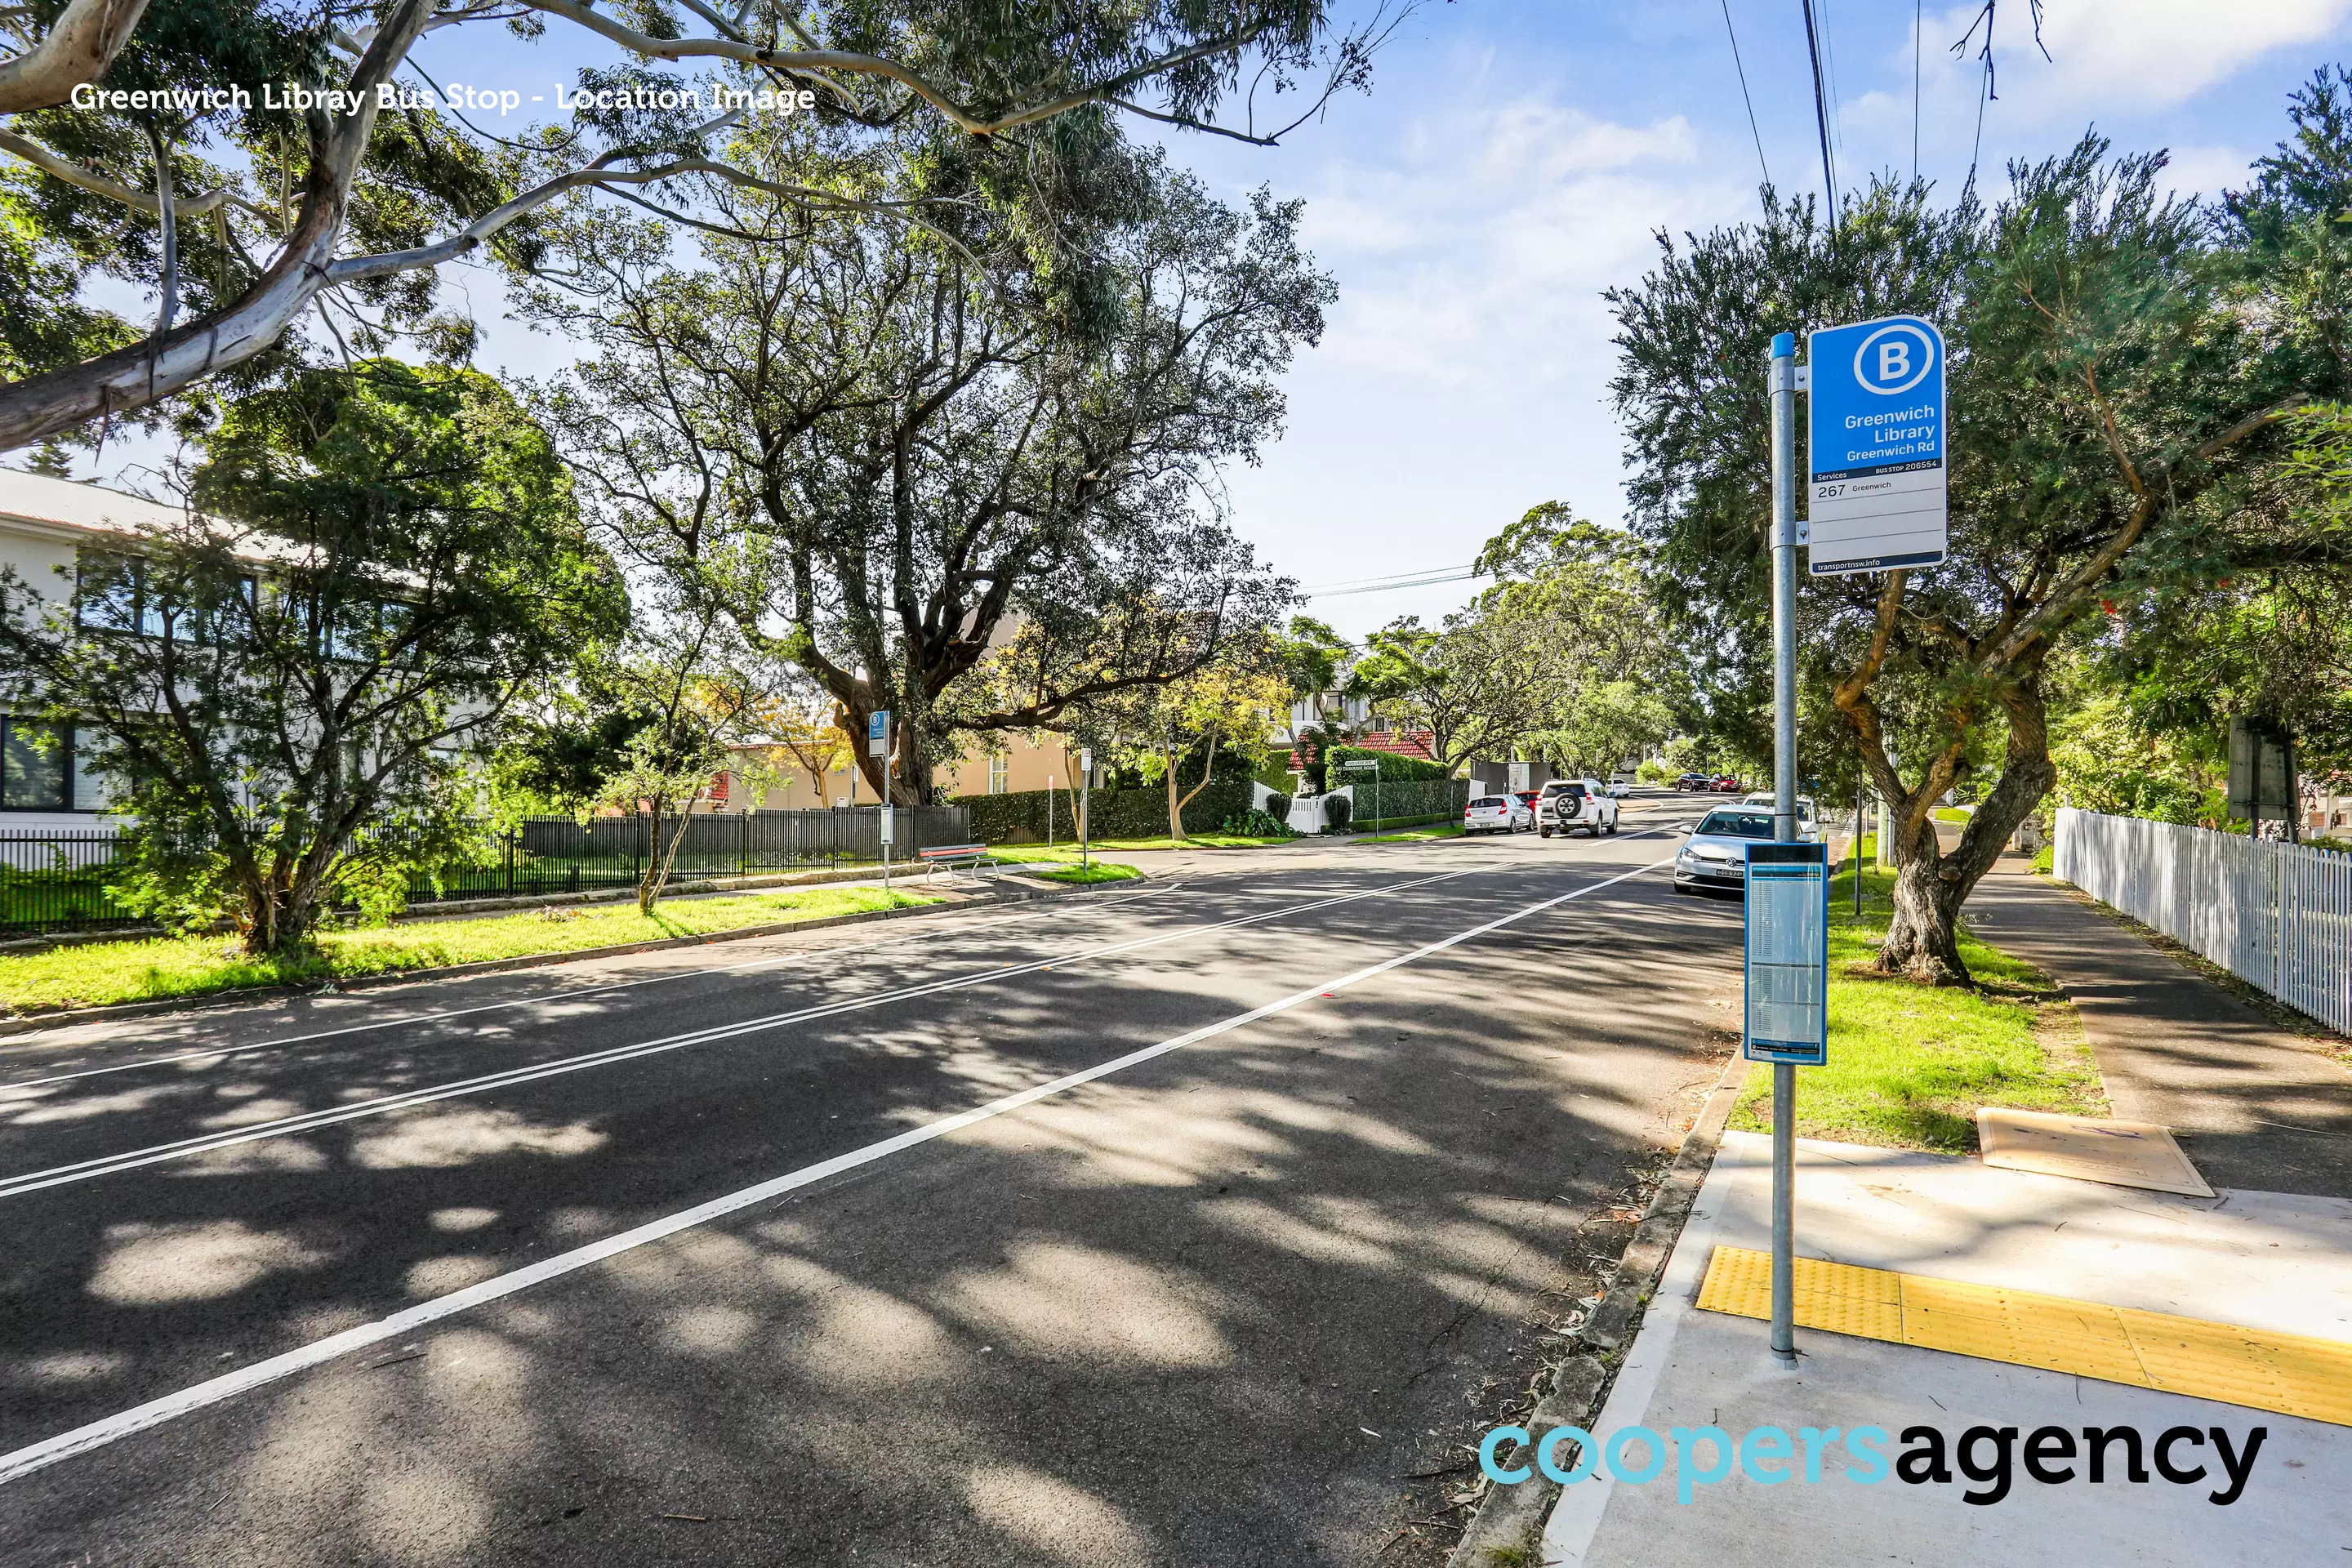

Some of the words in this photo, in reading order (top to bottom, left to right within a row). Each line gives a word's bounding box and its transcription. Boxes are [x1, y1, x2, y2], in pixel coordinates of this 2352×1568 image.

[1879, 341, 1910, 381] B
[1845, 405, 1935, 430] Greenwich
[1875, 425, 1936, 443] Library
[1847, 443, 1914, 461] Greenwich
[1918, 440, 1935, 452] Rd
[1905, 460, 1937, 471] 206554
[1817, 471, 1847, 482] Services
[1818, 484, 1846, 498] 267
[1852, 482, 1891, 492] Greenwich
[1817, 559, 1881, 571] transportnsw.info
